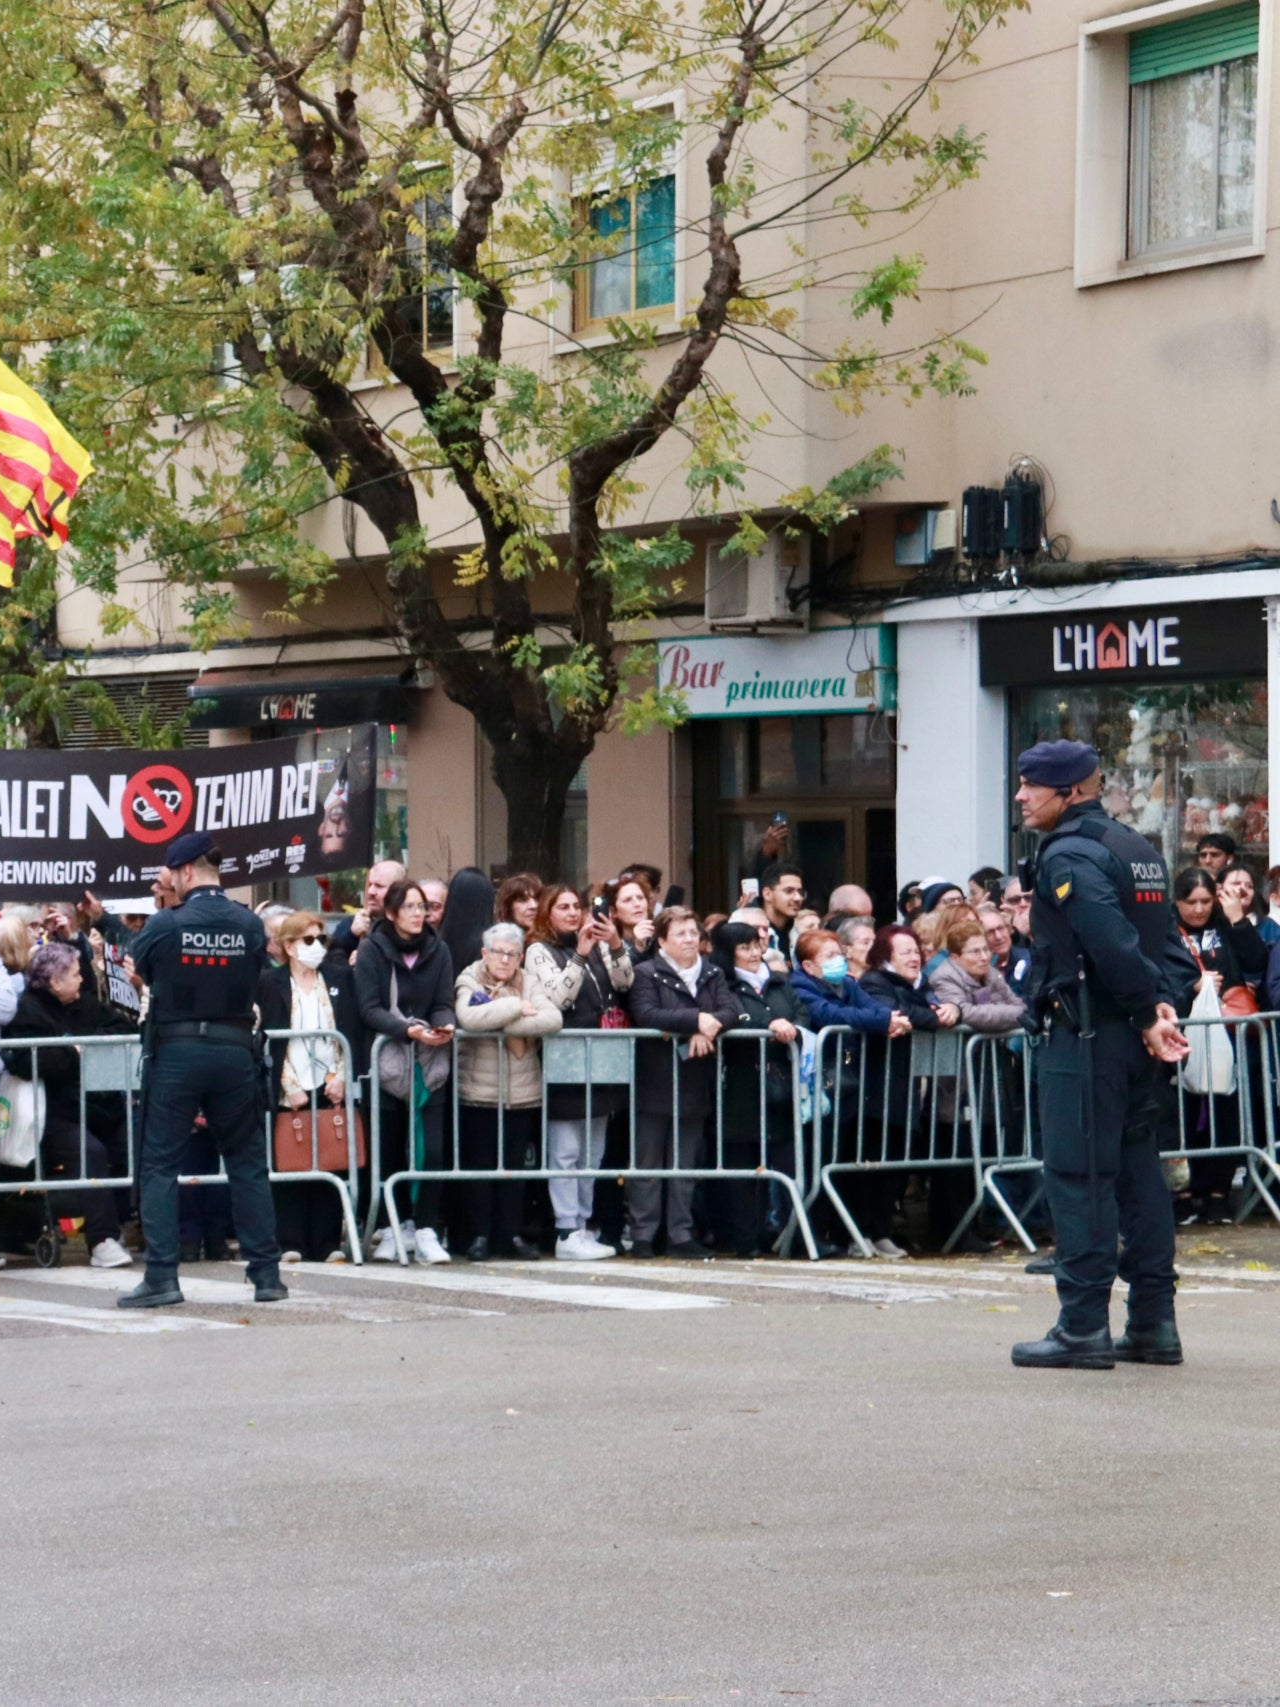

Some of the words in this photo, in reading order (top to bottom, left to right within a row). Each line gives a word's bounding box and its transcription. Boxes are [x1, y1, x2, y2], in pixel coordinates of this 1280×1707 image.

[661, 644, 725, 689] Bar
[725, 670, 846, 708] primavera
[195, 768, 273, 831] TENIM
[278, 761, 319, 820] REI
[182, 932, 246, 948] POLICIA
